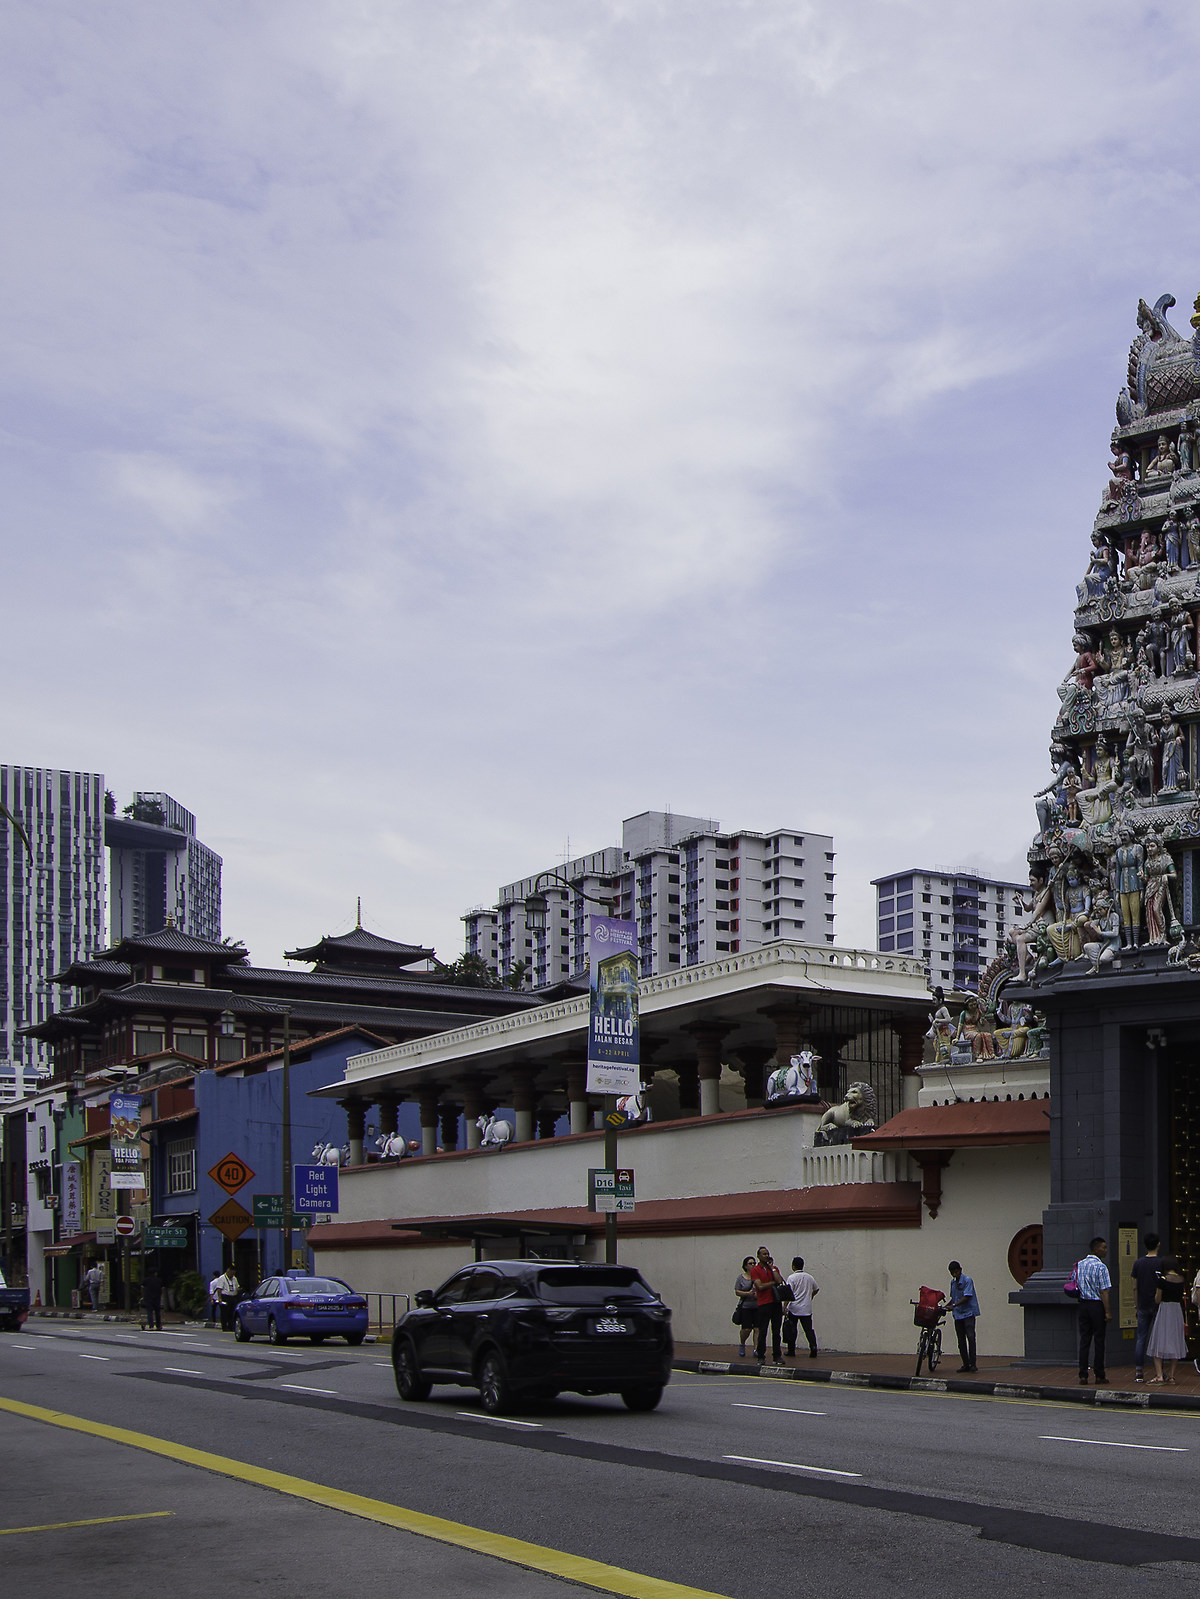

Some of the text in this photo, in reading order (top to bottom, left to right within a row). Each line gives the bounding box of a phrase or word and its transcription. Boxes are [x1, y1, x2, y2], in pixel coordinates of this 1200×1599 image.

[594, 1016, 634, 1037] HELLO
[594, 1035, 634, 1046] JALAN BESAR
[114, 1148, 138, 1158] HELLO
[224, 1168, 239, 1180] 40
[308, 1170, 325, 1181] Red
[98, 1161, 112, 1213] TAILORS
[596, 1179, 613, 1187] D16
[619, 1184, 632, 1192] Taxi
[306, 1184, 328, 1196] Light
[299, 1197, 332, 1208] Camera
[616, 1199, 624, 1210] 4
[214, 1215, 250, 1225] CAUTION
